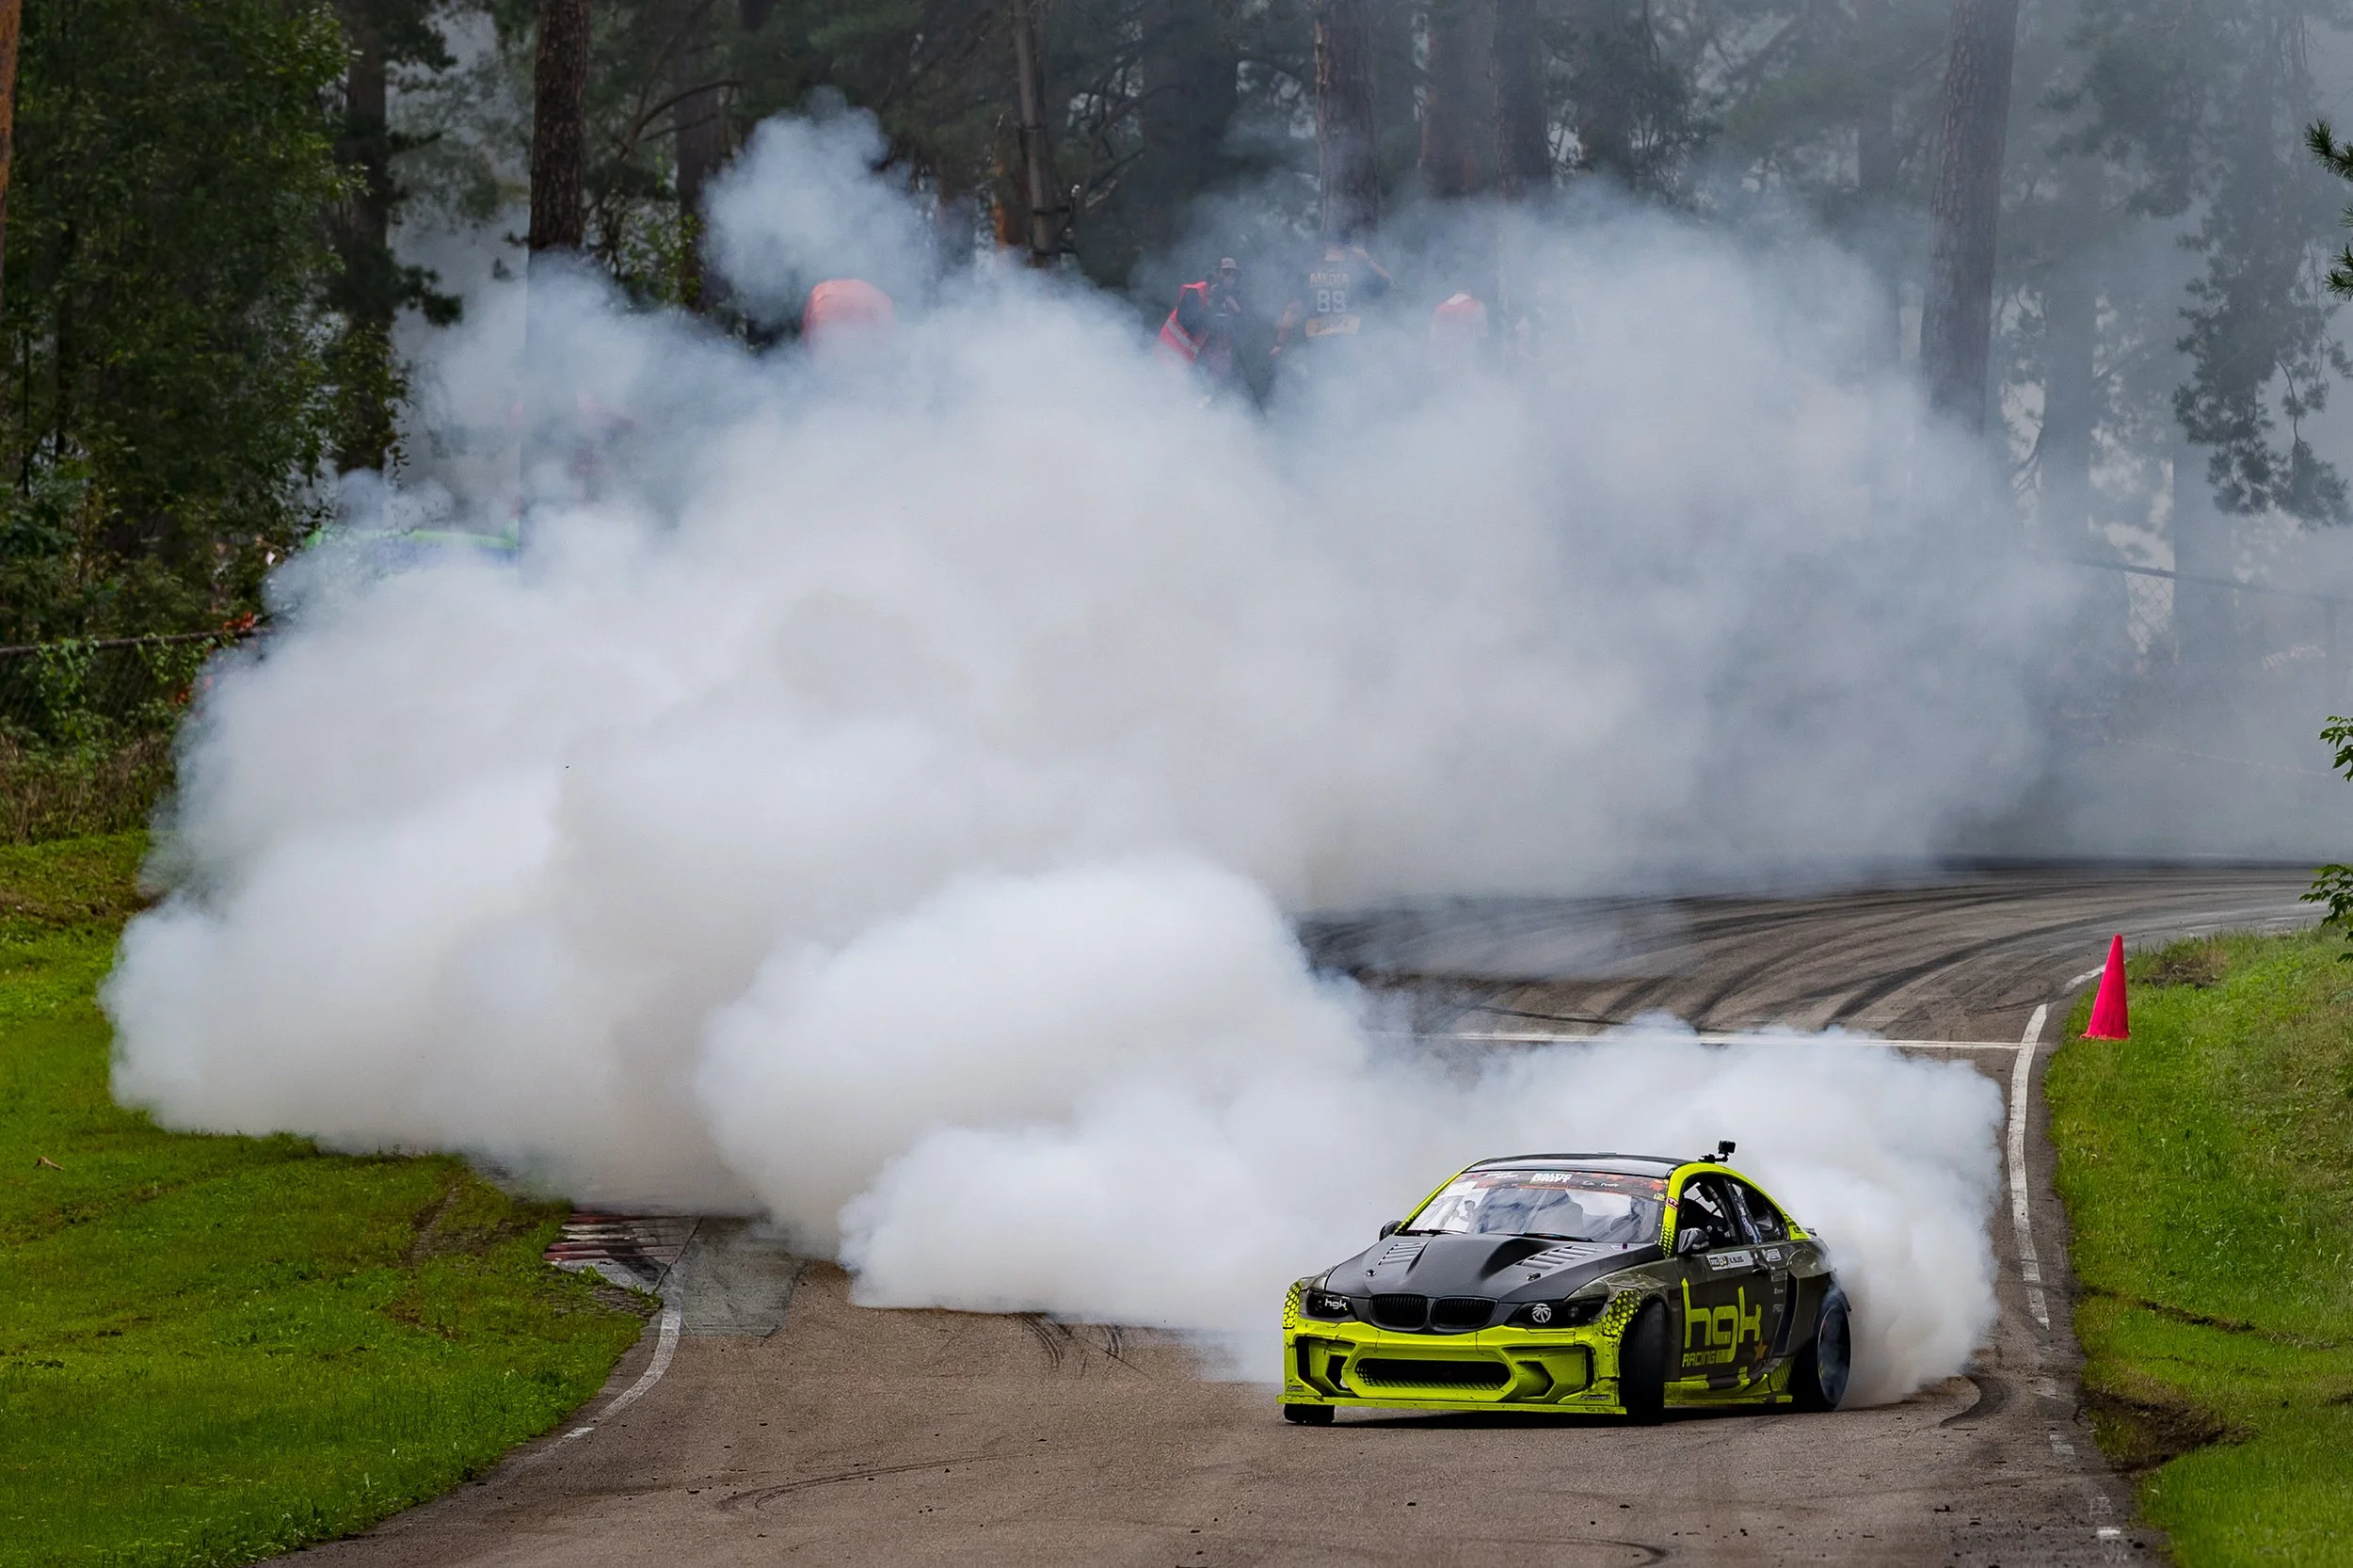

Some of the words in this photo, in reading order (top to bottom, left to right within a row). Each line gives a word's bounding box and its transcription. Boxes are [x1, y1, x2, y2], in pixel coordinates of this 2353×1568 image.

[1325, 1298, 1347, 1310] hgk
[1681, 1277, 1761, 1362] hgk
[1682, 1351, 1717, 1367] RACING
